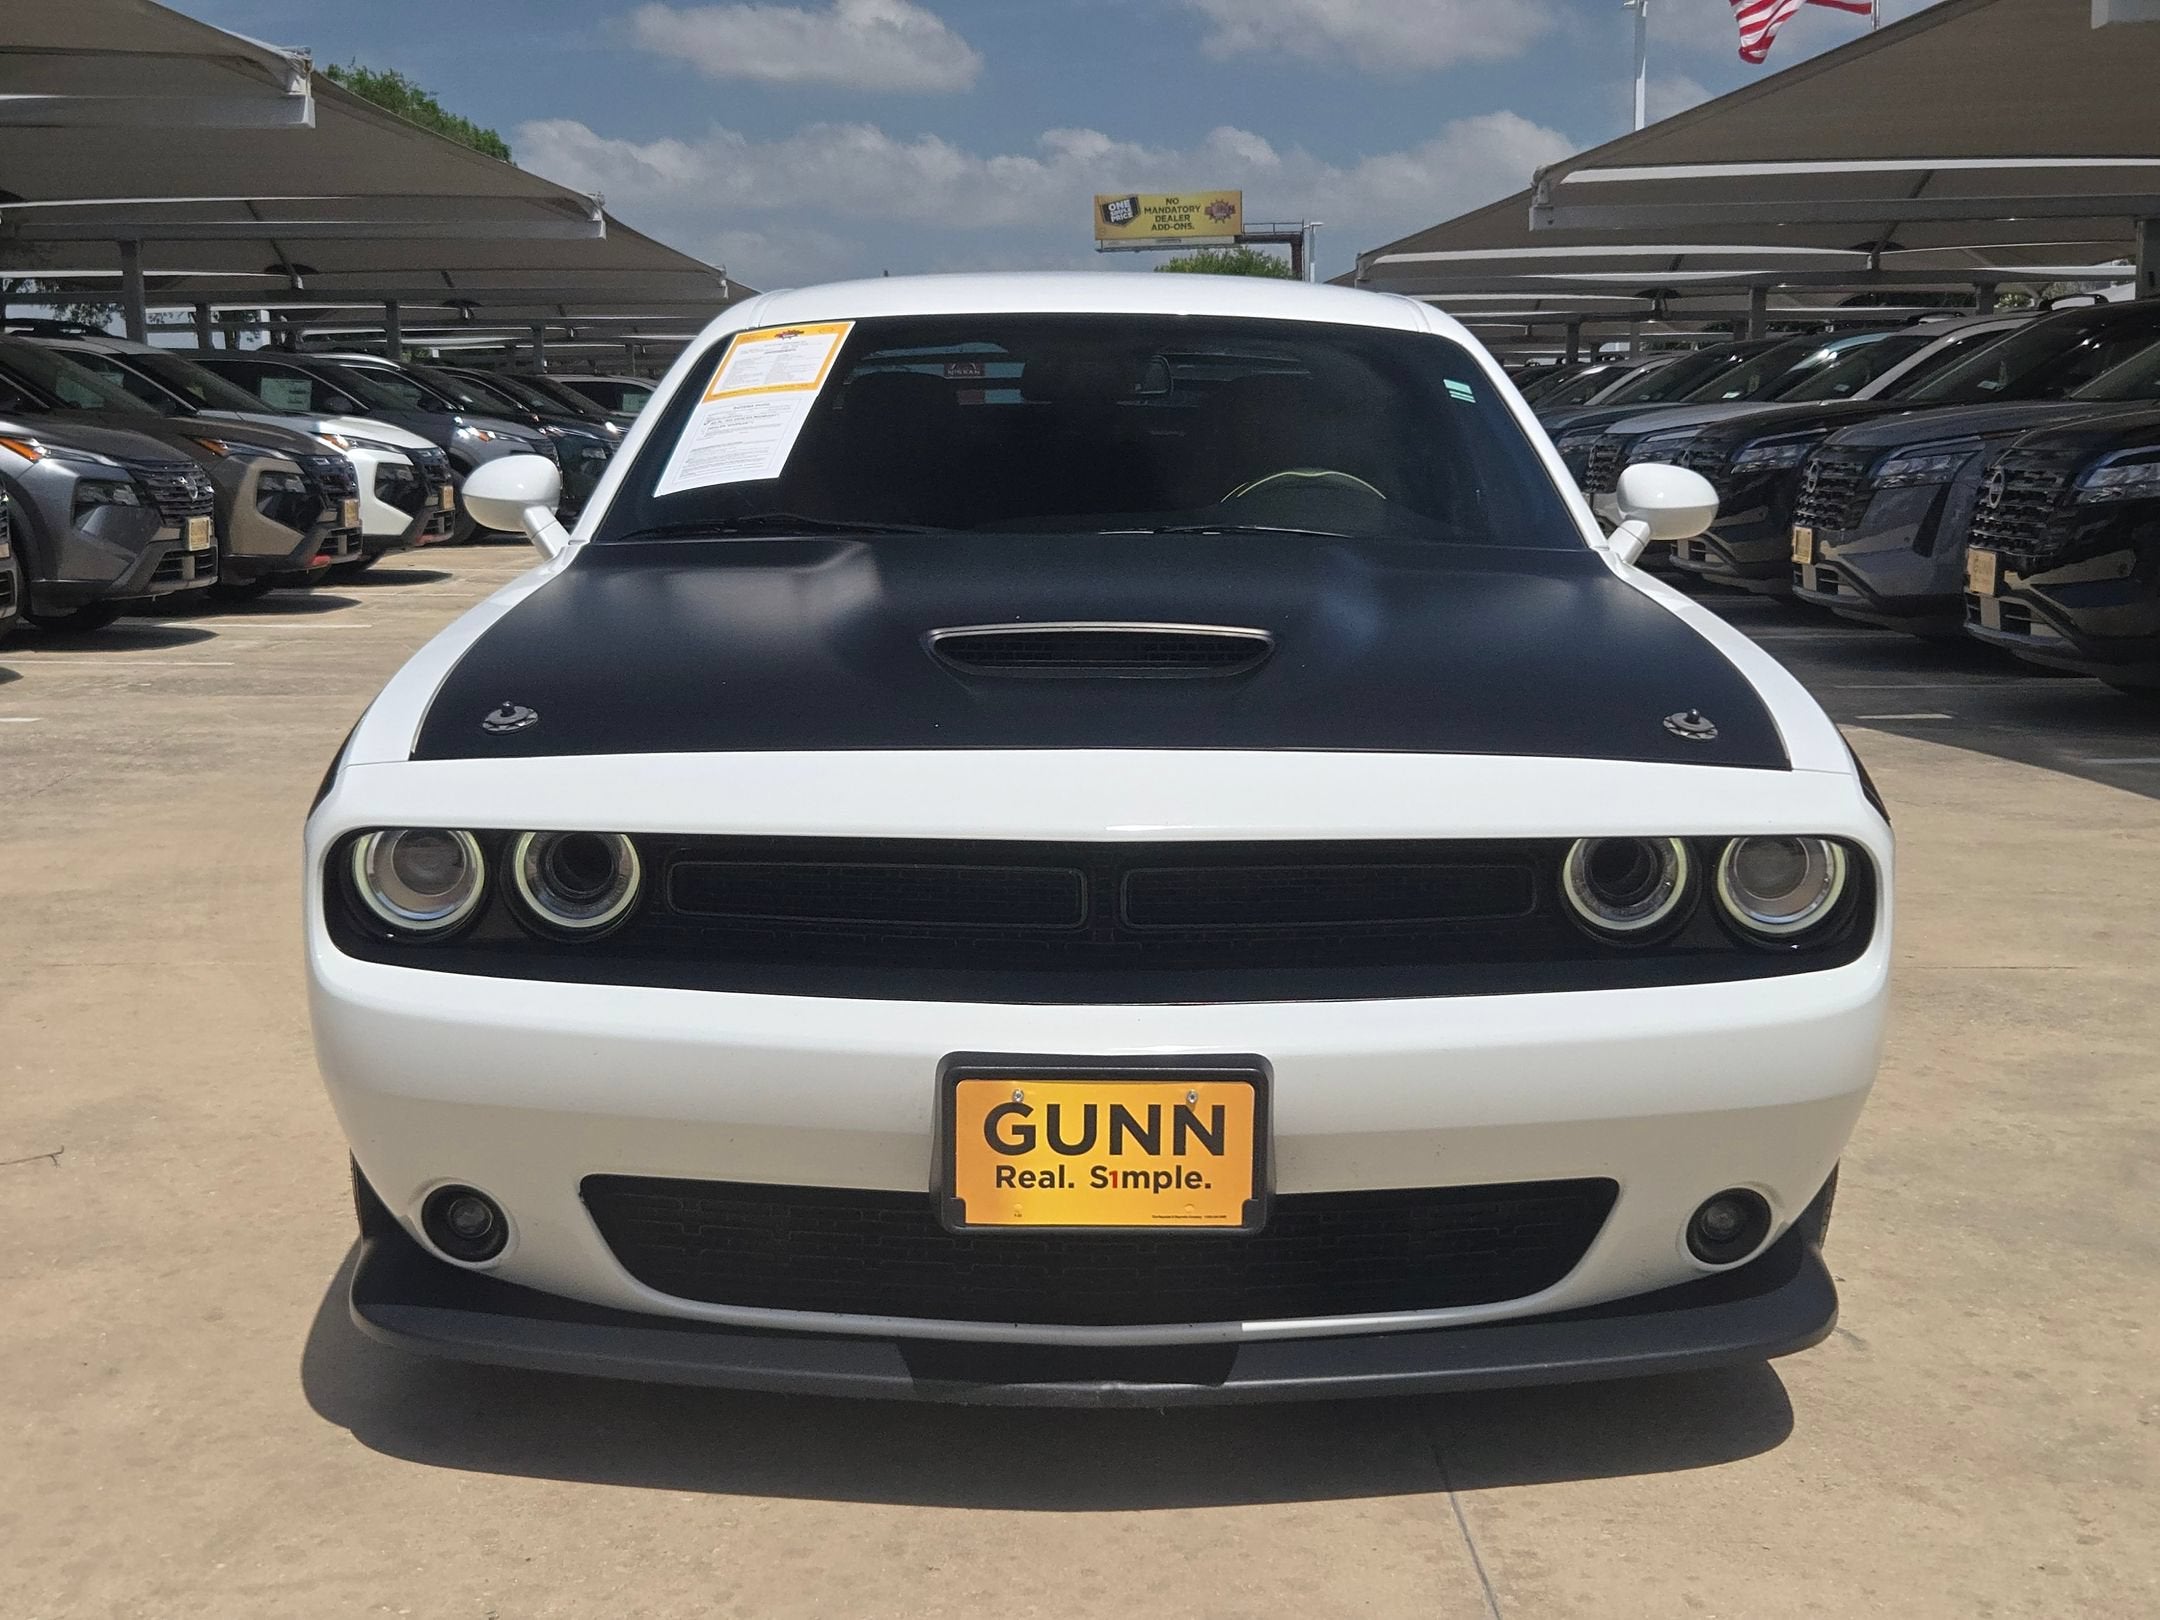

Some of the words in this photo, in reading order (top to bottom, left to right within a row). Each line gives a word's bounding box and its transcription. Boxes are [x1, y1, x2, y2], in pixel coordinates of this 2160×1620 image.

[1108, 200, 1131, 211] ONE
[1144, 205, 1201, 214] MANDATORY
[1111, 212, 1134, 223] PRICE
[1155, 214, 1190, 223] DEALER
[1151, 222, 1195, 231] ADD-ONS.
[983, 1102, 1225, 1156] GUNN
[995, 1165, 1075, 1189] Real.
